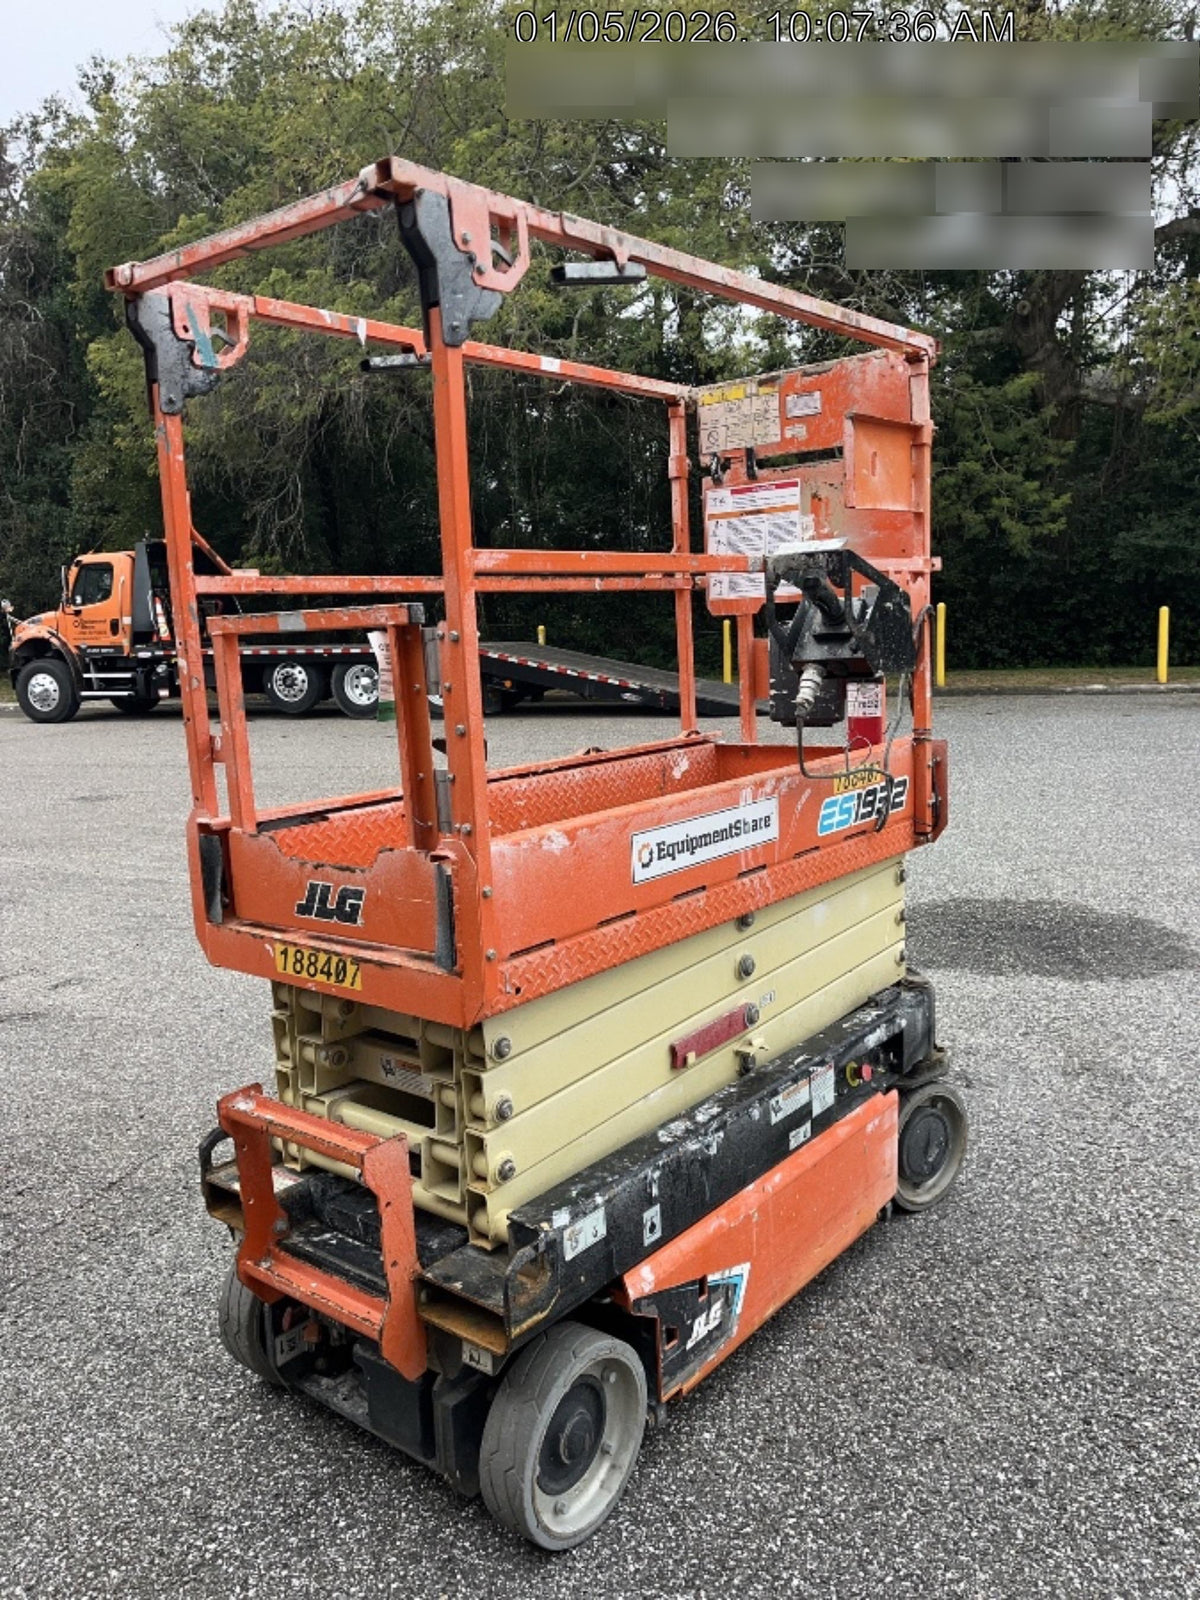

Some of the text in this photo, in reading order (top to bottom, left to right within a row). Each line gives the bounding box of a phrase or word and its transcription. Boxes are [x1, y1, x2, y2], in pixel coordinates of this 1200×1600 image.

[819, 777, 908, 835] ES1932
[656, 814, 771, 861] EquipmentShare
[295, 881, 365, 926] JLG
[279, 947, 361, 987] 188407
